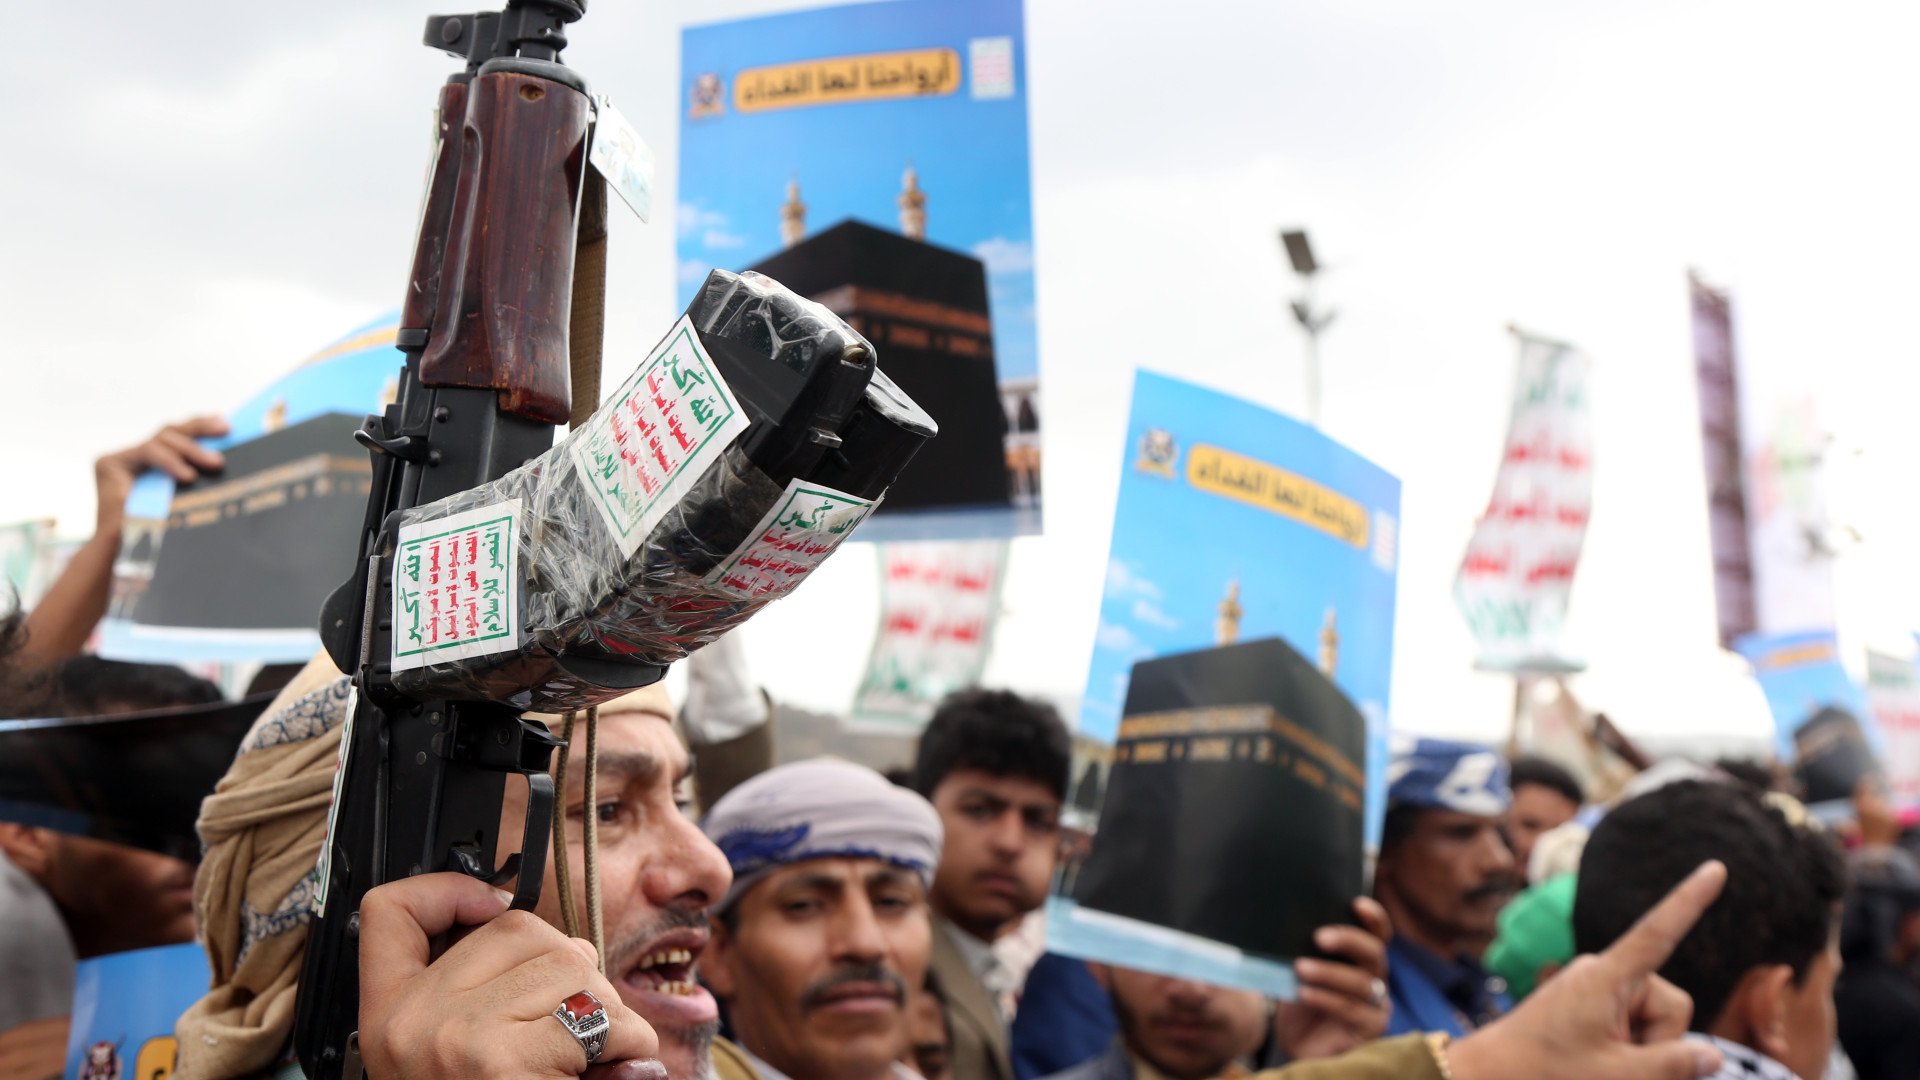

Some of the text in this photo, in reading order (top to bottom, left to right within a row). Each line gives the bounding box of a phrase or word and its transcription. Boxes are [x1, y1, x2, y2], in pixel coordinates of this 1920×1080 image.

[817, 63, 859, 92] لها
[646, 366, 698, 455] الموت لأمريكا
[663, 354, 723, 431] الله أكبر
[648, 435, 679, 477] الموت
[779, 500, 834, 533] أكبر
[400, 544, 424, 646] الله أكبر
[425, 540, 441, 644] الموت لأمريكا
[445, 535, 460, 640] الموت لإسرائيل
[463, 531, 480, 636] اللعنة على اليهود
[482, 526, 505, 632] النصر للإسلام
